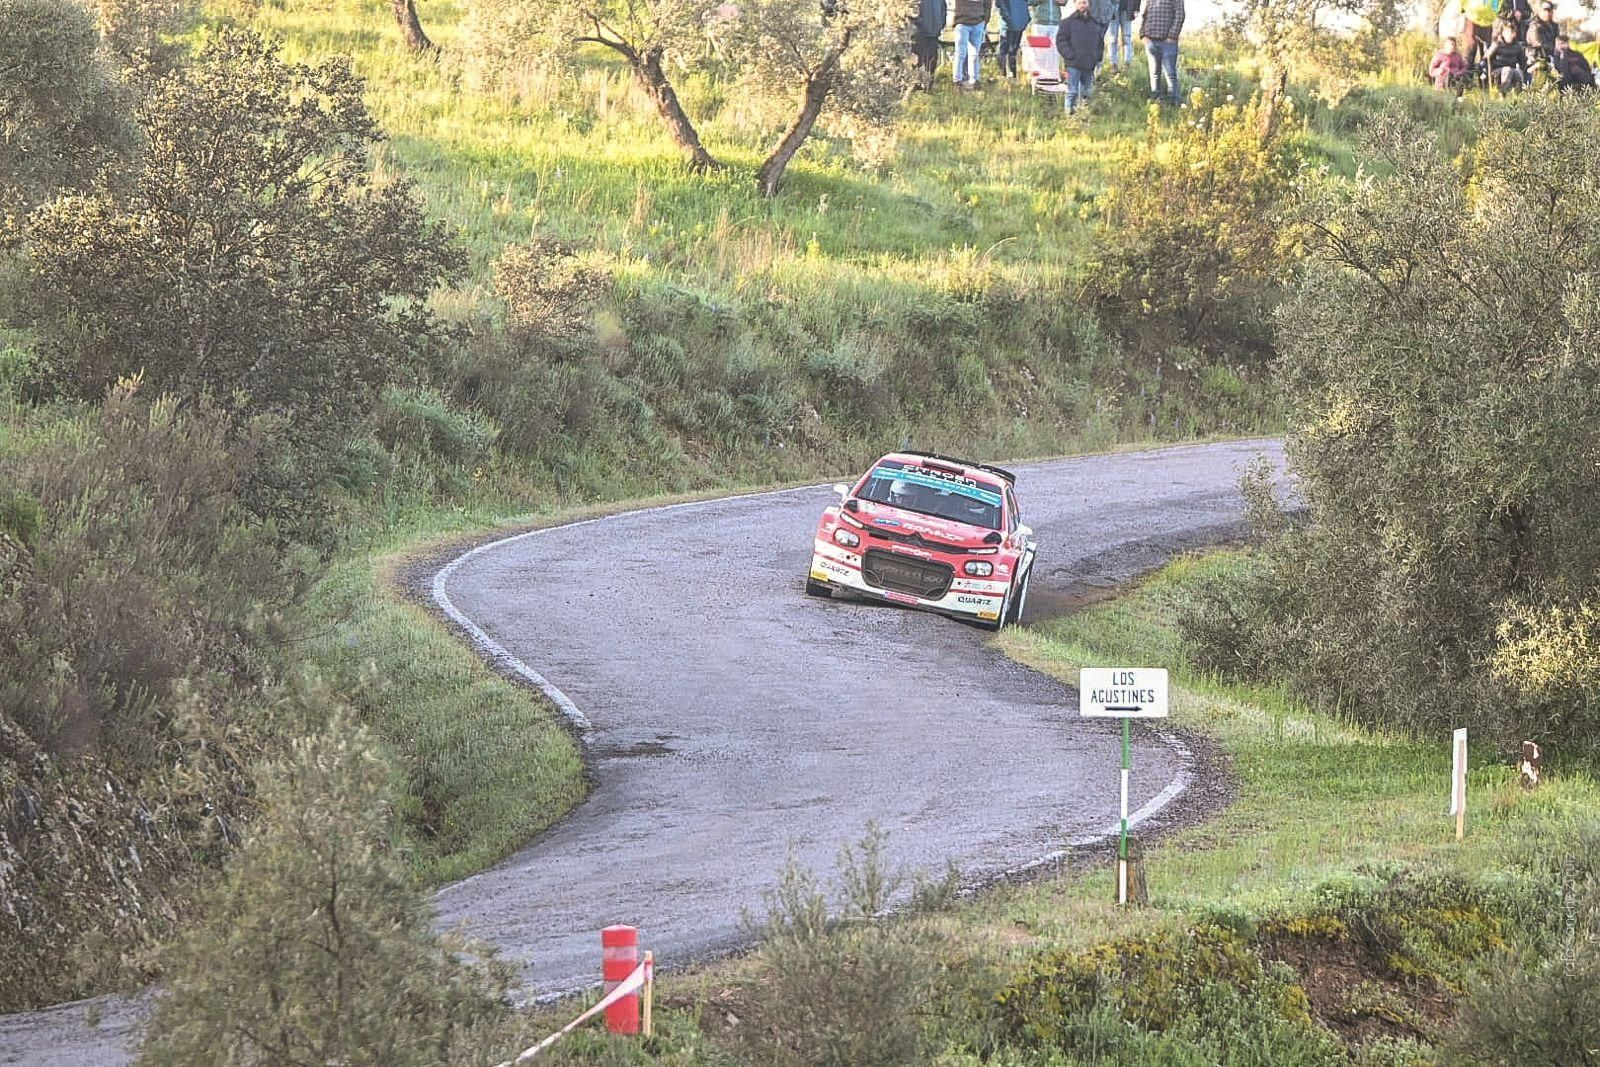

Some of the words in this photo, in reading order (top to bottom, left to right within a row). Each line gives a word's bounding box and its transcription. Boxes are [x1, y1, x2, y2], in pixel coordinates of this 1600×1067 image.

[957, 596, 991, 606] QUARTZ
[1112, 671, 1135, 686] LOS
[1090, 689, 1155, 704] AGUSTINES
